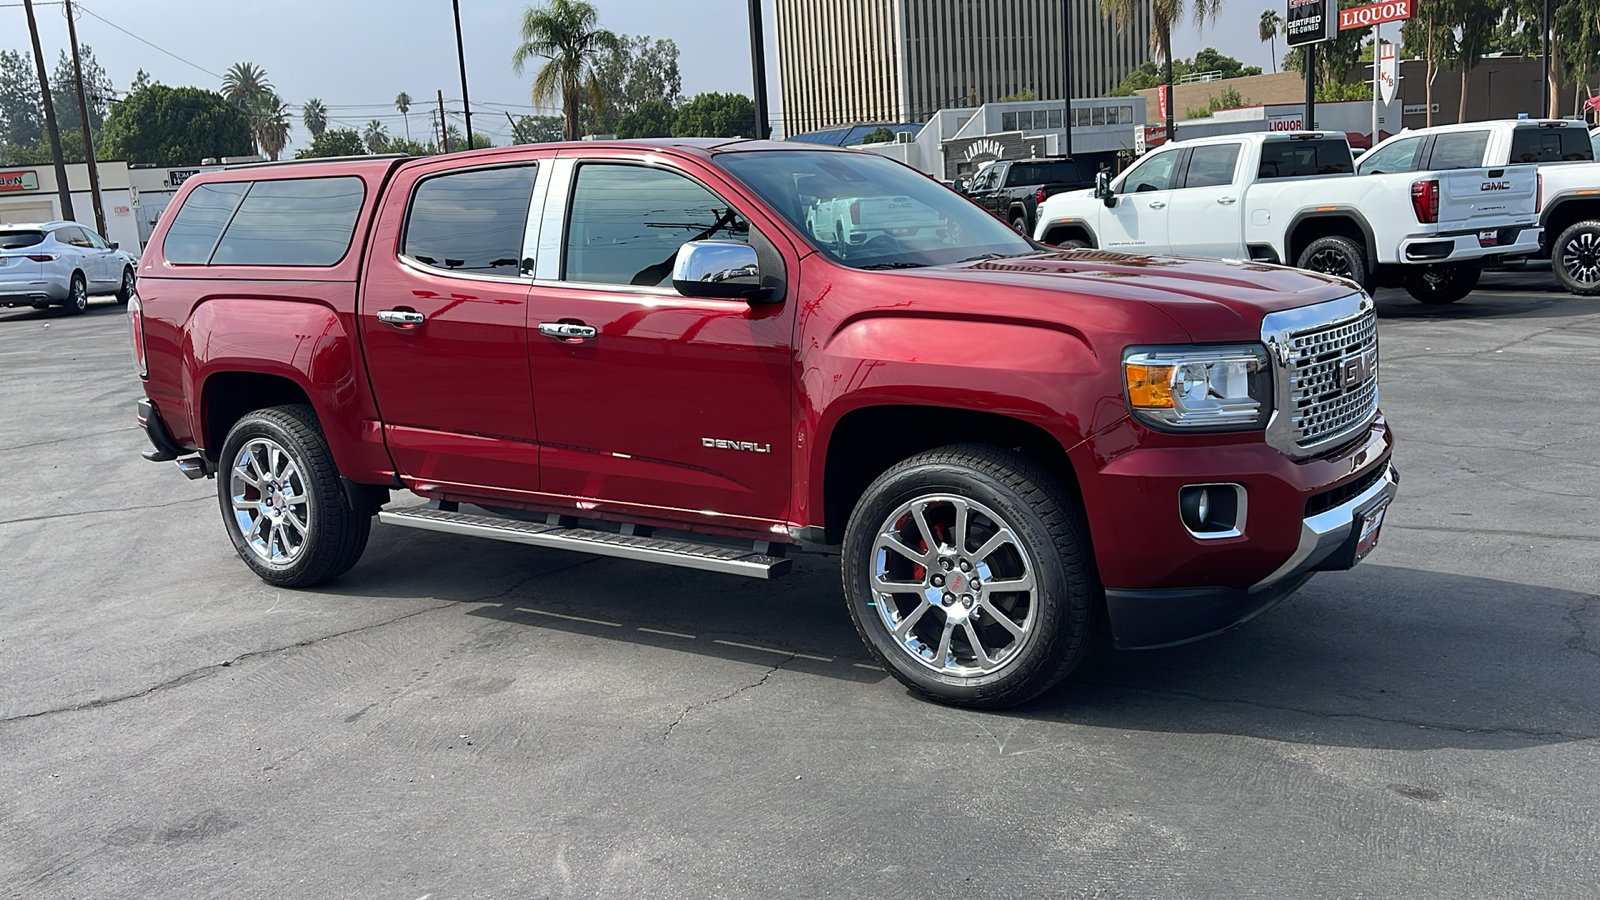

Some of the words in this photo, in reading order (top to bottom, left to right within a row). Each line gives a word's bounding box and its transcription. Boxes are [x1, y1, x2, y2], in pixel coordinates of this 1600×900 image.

[1342, 2, 1407, 27] LIQUOR
[1288, 15, 1322, 29] CERTIFIED
[1289, 23, 1319, 35] PRE-OWNED
[1269, 120, 1302, 131] LIQUOR
[1146, 131, 1166, 141] Landma
[964, 139, 1005, 162] LANDMARK
[1136, 141, 1144, 152] 30
[1481, 181, 1510, 191] GMC
[702, 437, 771, 453] DENALI
